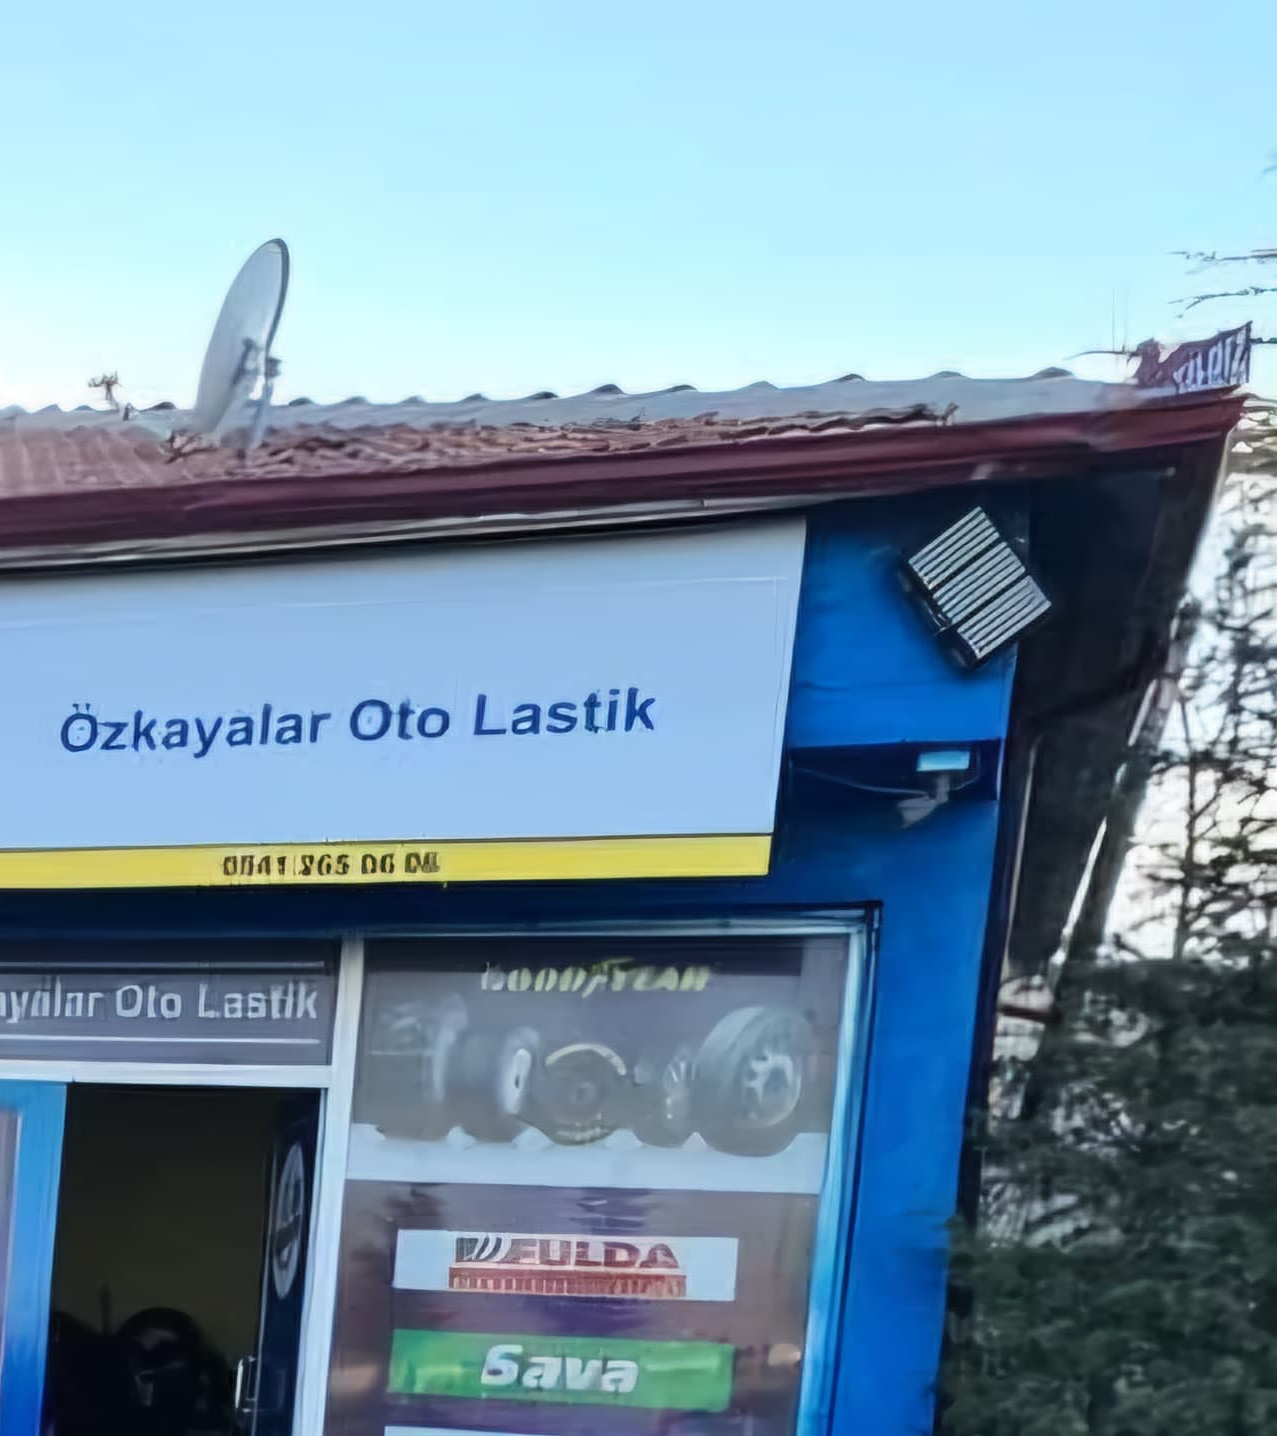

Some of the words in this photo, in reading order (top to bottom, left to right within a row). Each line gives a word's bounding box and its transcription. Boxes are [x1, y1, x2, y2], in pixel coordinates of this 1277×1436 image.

[60, 702, 332, 758] Özkayalar
[349, 697, 451, 742] Oto
[473, 687, 656, 736] Lastik
[116, 984, 182, 1020] Oto
[197, 981, 318, 1020] Lastik
[481, 1344, 638, 1393] Sava
